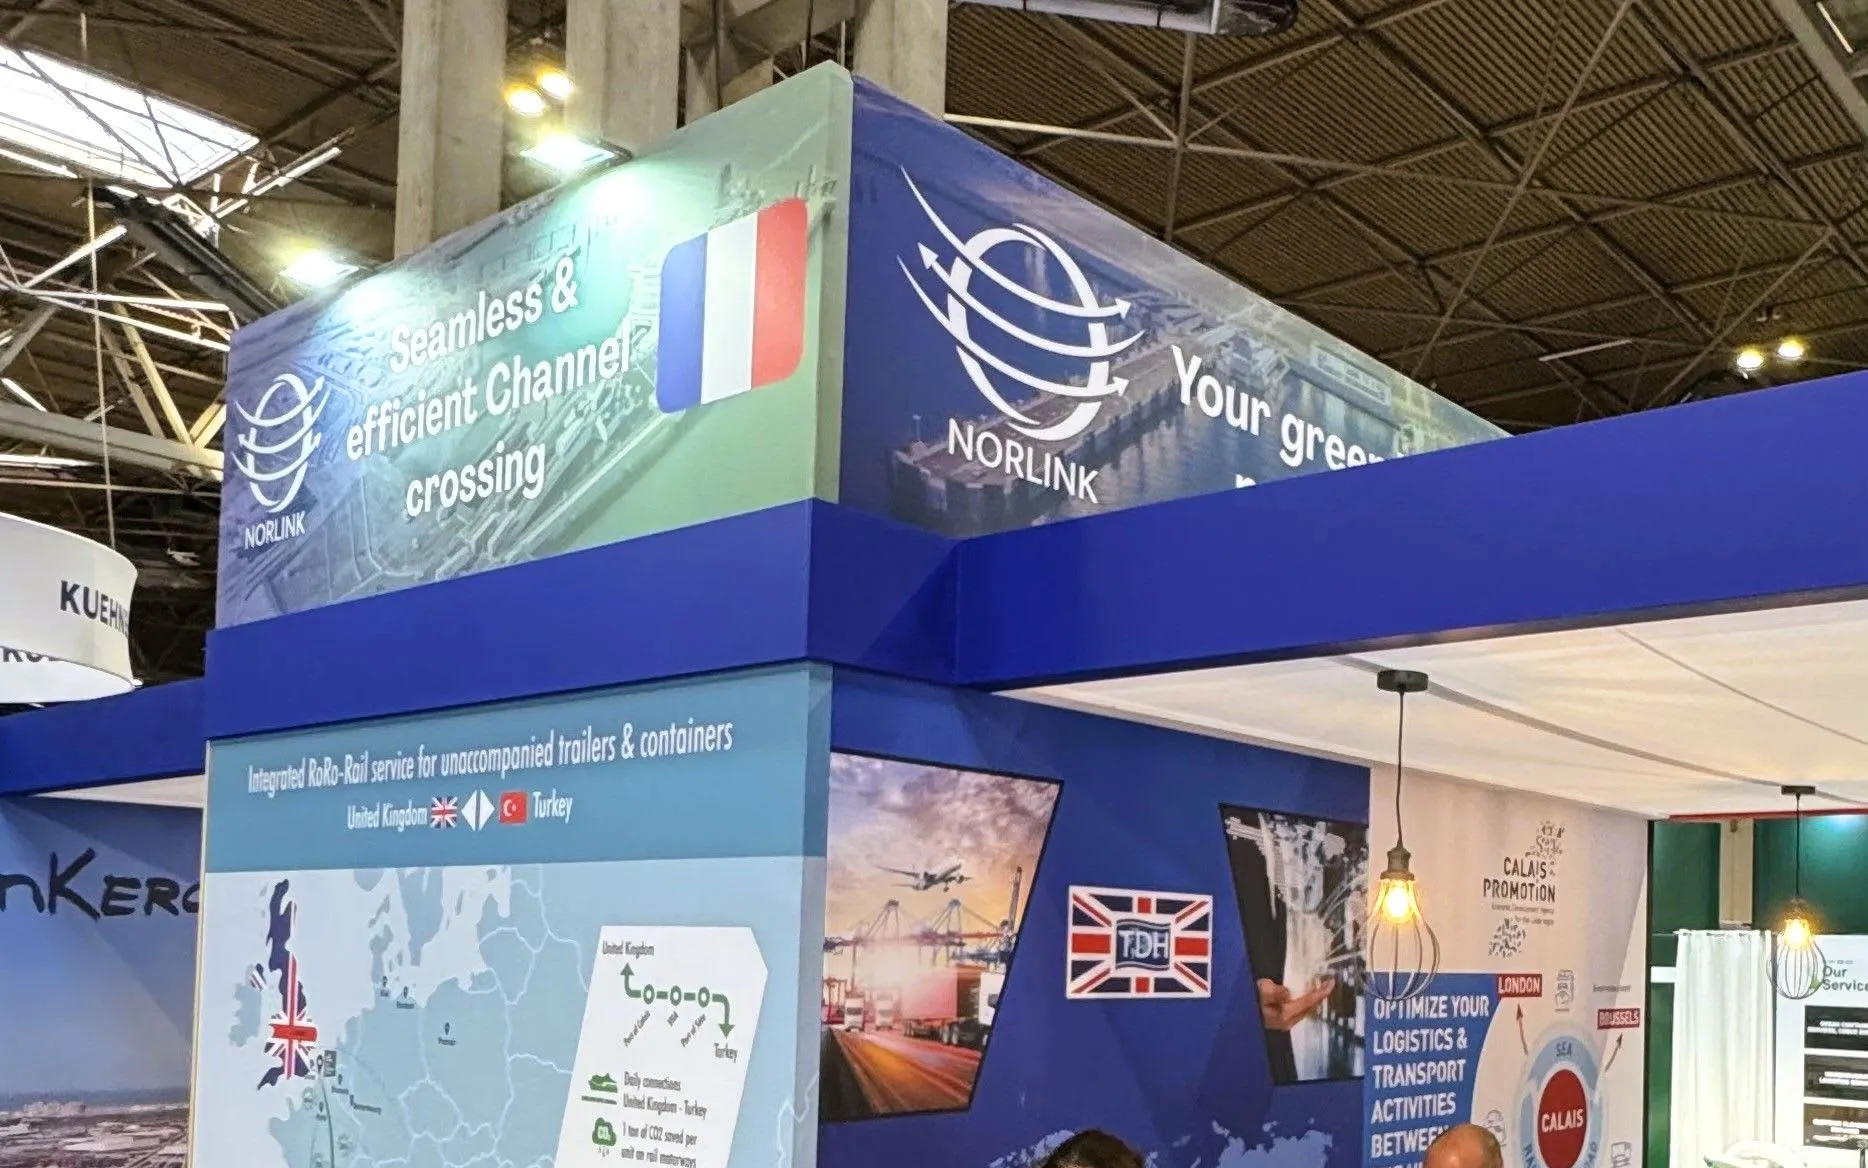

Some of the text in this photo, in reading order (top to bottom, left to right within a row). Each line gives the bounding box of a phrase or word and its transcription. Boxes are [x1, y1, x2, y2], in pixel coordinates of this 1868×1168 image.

[389, 256, 578, 374] Seamless &
[346, 326, 632, 461] efficient Channel
[1170, 344, 1385, 471] Your gree
[948, 418, 1099, 504] NORLINK
[405, 442, 546, 517] crossing
[244, 512, 306, 550] NORLINK
[61, 579, 129, 640] KUEHN
[248, 719, 733, 799] Integrated RoRo-Rail service for unaccompanied trailers & containers
[347, 800, 428, 832] United Kingdom
[532, 791, 573, 825] Turkey
[1503, 857, 1547, 879] CALAIS
[602, 940, 655, 960] United Kingdom
[1117, 929, 1169, 959] TDH
[1497, 976, 1541, 995] LONDON
[1823, 965, 1848, 978] Our
[1373, 995, 1490, 1020] OPTIMIZE YOUR
[713, 1042, 739, 1064] Turkey
[1372, 1026, 1469, 1056] LOGISTICS &
[1556, 1041, 1573, 1057] SEA
[623, 1071, 641, 1090] Daily
[1371, 1058, 1467, 1089] TRANSPORT
[623, 1093, 646, 1110] United
[646, 1096, 677, 1116] Kingdom
[684, 1099, 708, 1121] Turkey
[1370, 1092, 1457, 1125] ACTIVITIES
[1541, 1108, 1585, 1134] CALAIS
[648, 1125, 664, 1142] CO2
